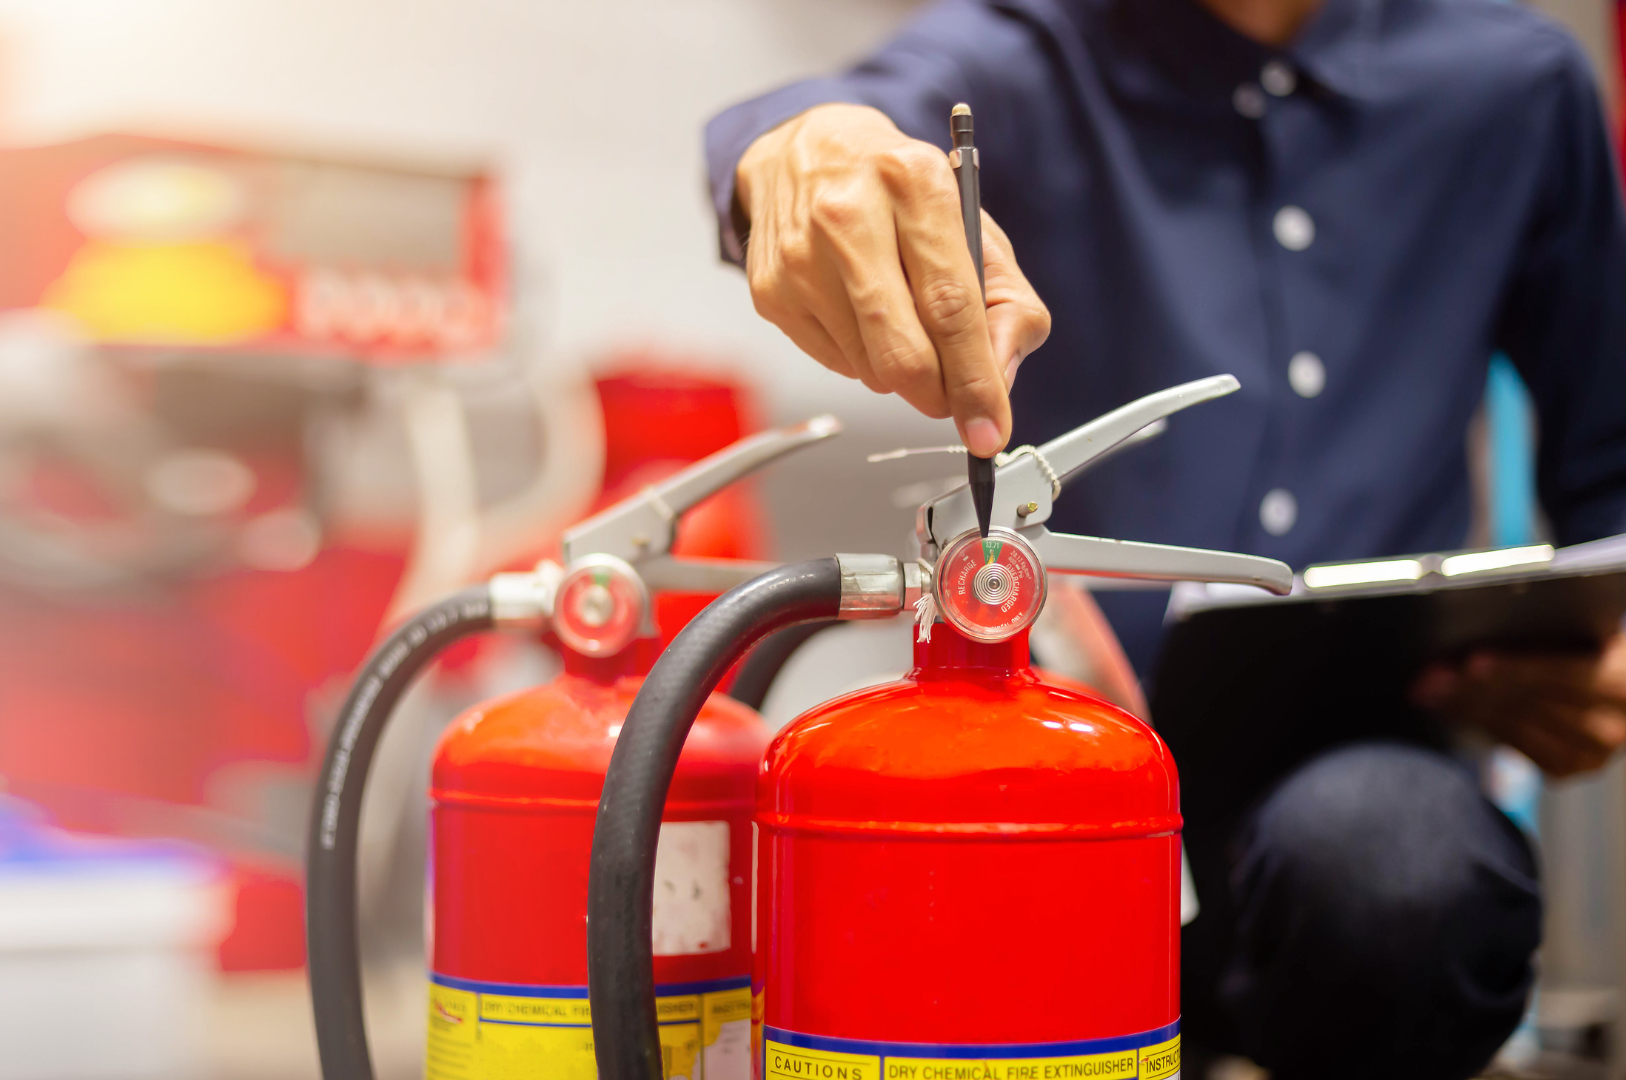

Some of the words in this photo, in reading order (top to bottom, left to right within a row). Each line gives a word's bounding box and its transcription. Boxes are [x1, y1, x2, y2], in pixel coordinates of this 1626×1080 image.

[957, 559, 977, 596] RECHARGE
[1000, 564, 1020, 613] OVERCHARGED
[774, 1056, 862, 1080] CAUTIONS
[888, 1065, 918, 1080] DRY
[922, 1066, 1002, 1080] CHEMICAL
[1006, 1066, 1039, 1080] FIRE
[1044, 1057, 1134, 1079] EXTINGUISHER
